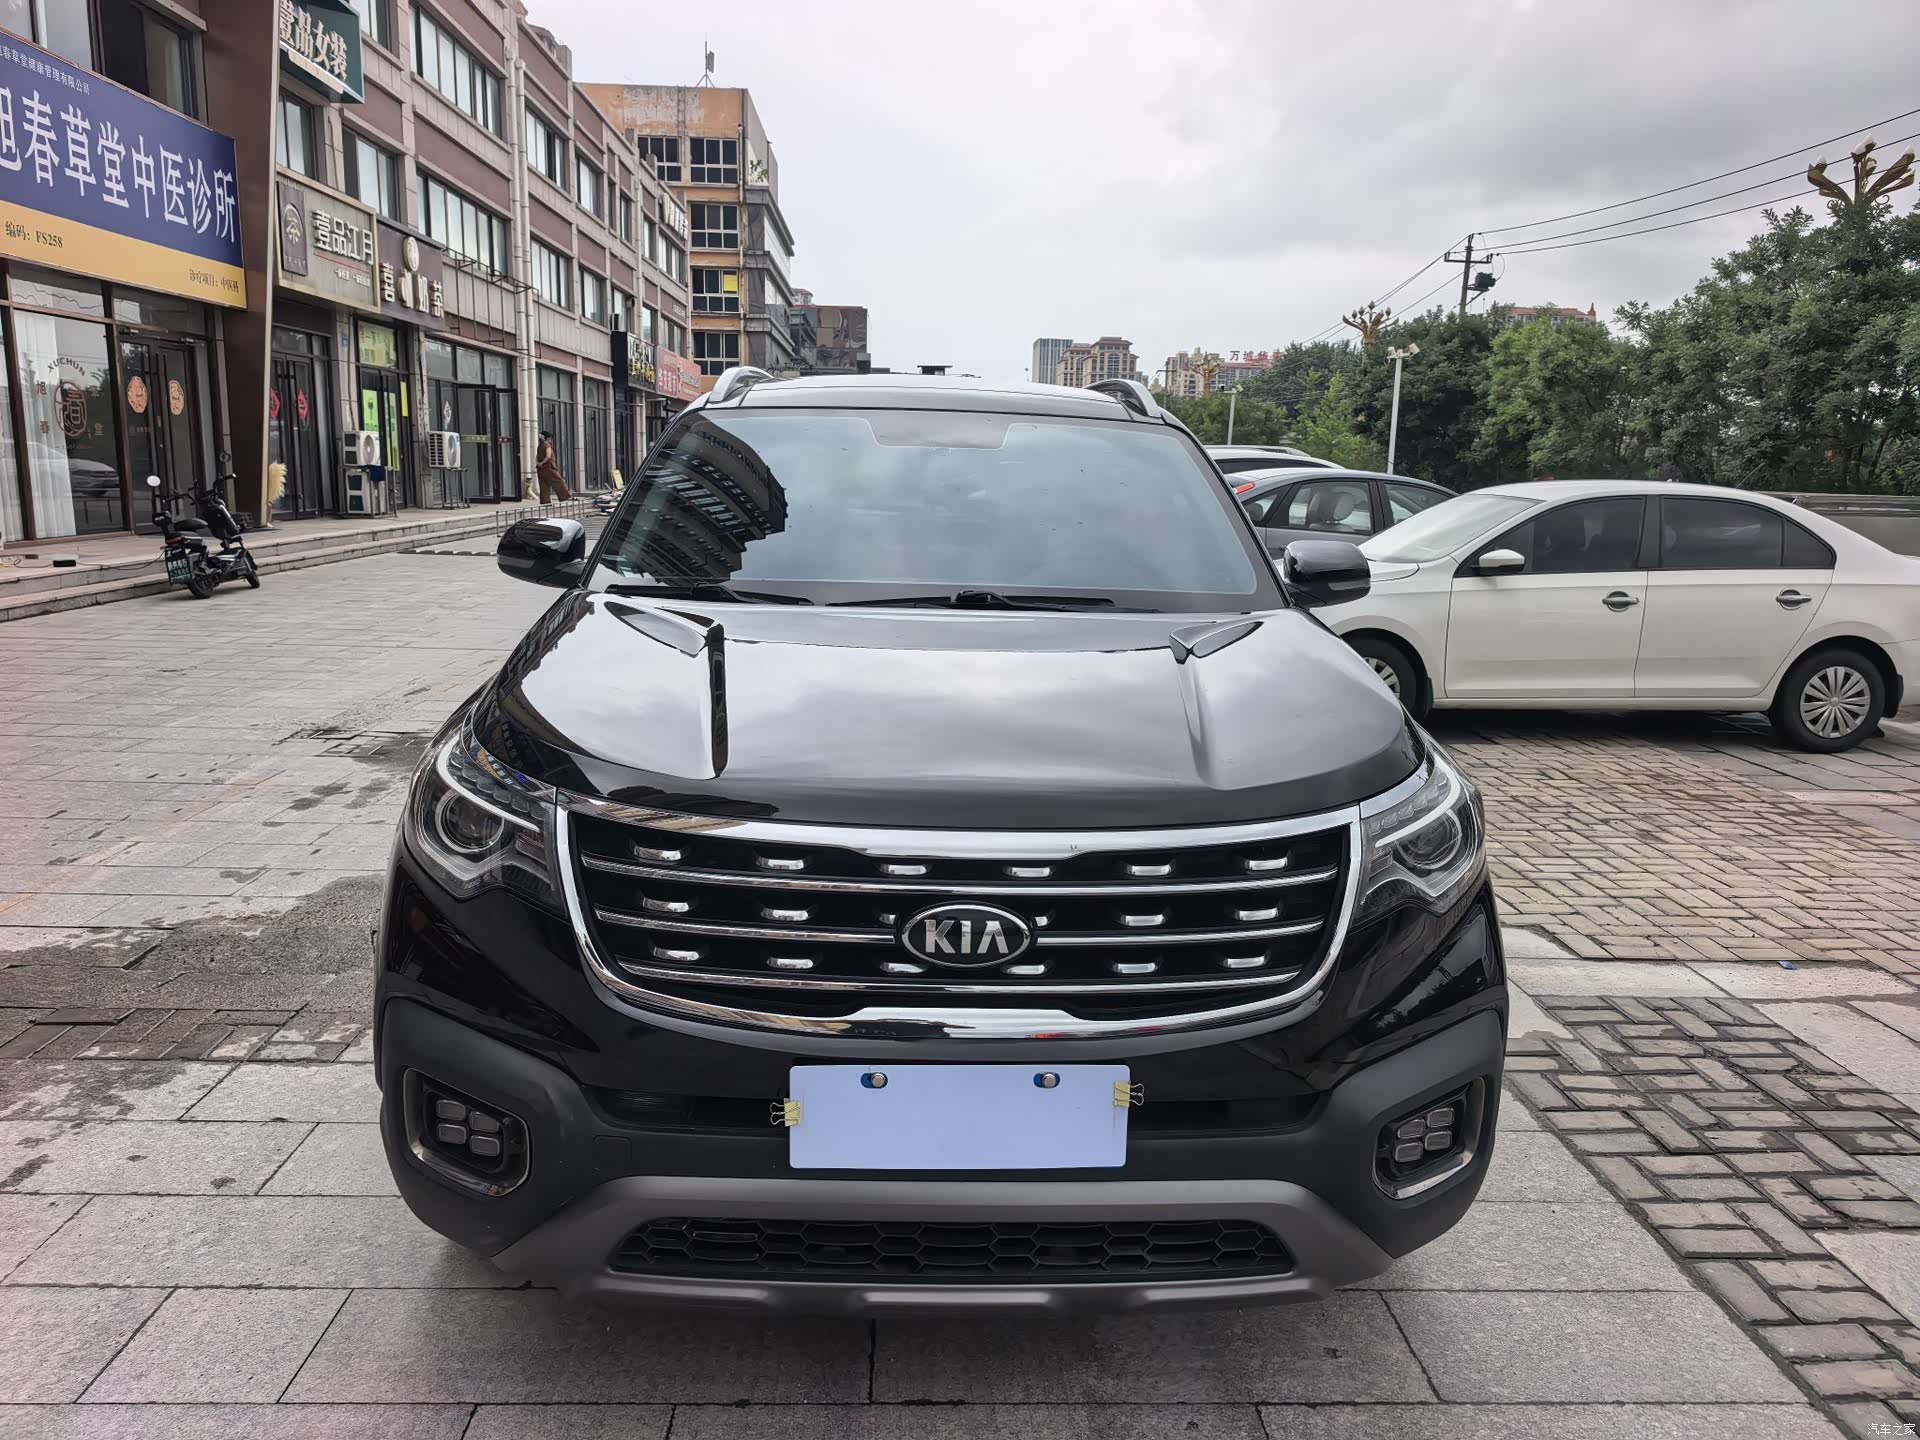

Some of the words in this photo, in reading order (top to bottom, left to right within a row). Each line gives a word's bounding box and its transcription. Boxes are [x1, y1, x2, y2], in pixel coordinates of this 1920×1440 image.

[0, 45, 90, 96] 春草堂健康管理有限公司
[48, 357, 86, 377] XUCHUN
[924, 919, 1009, 954] KIA
